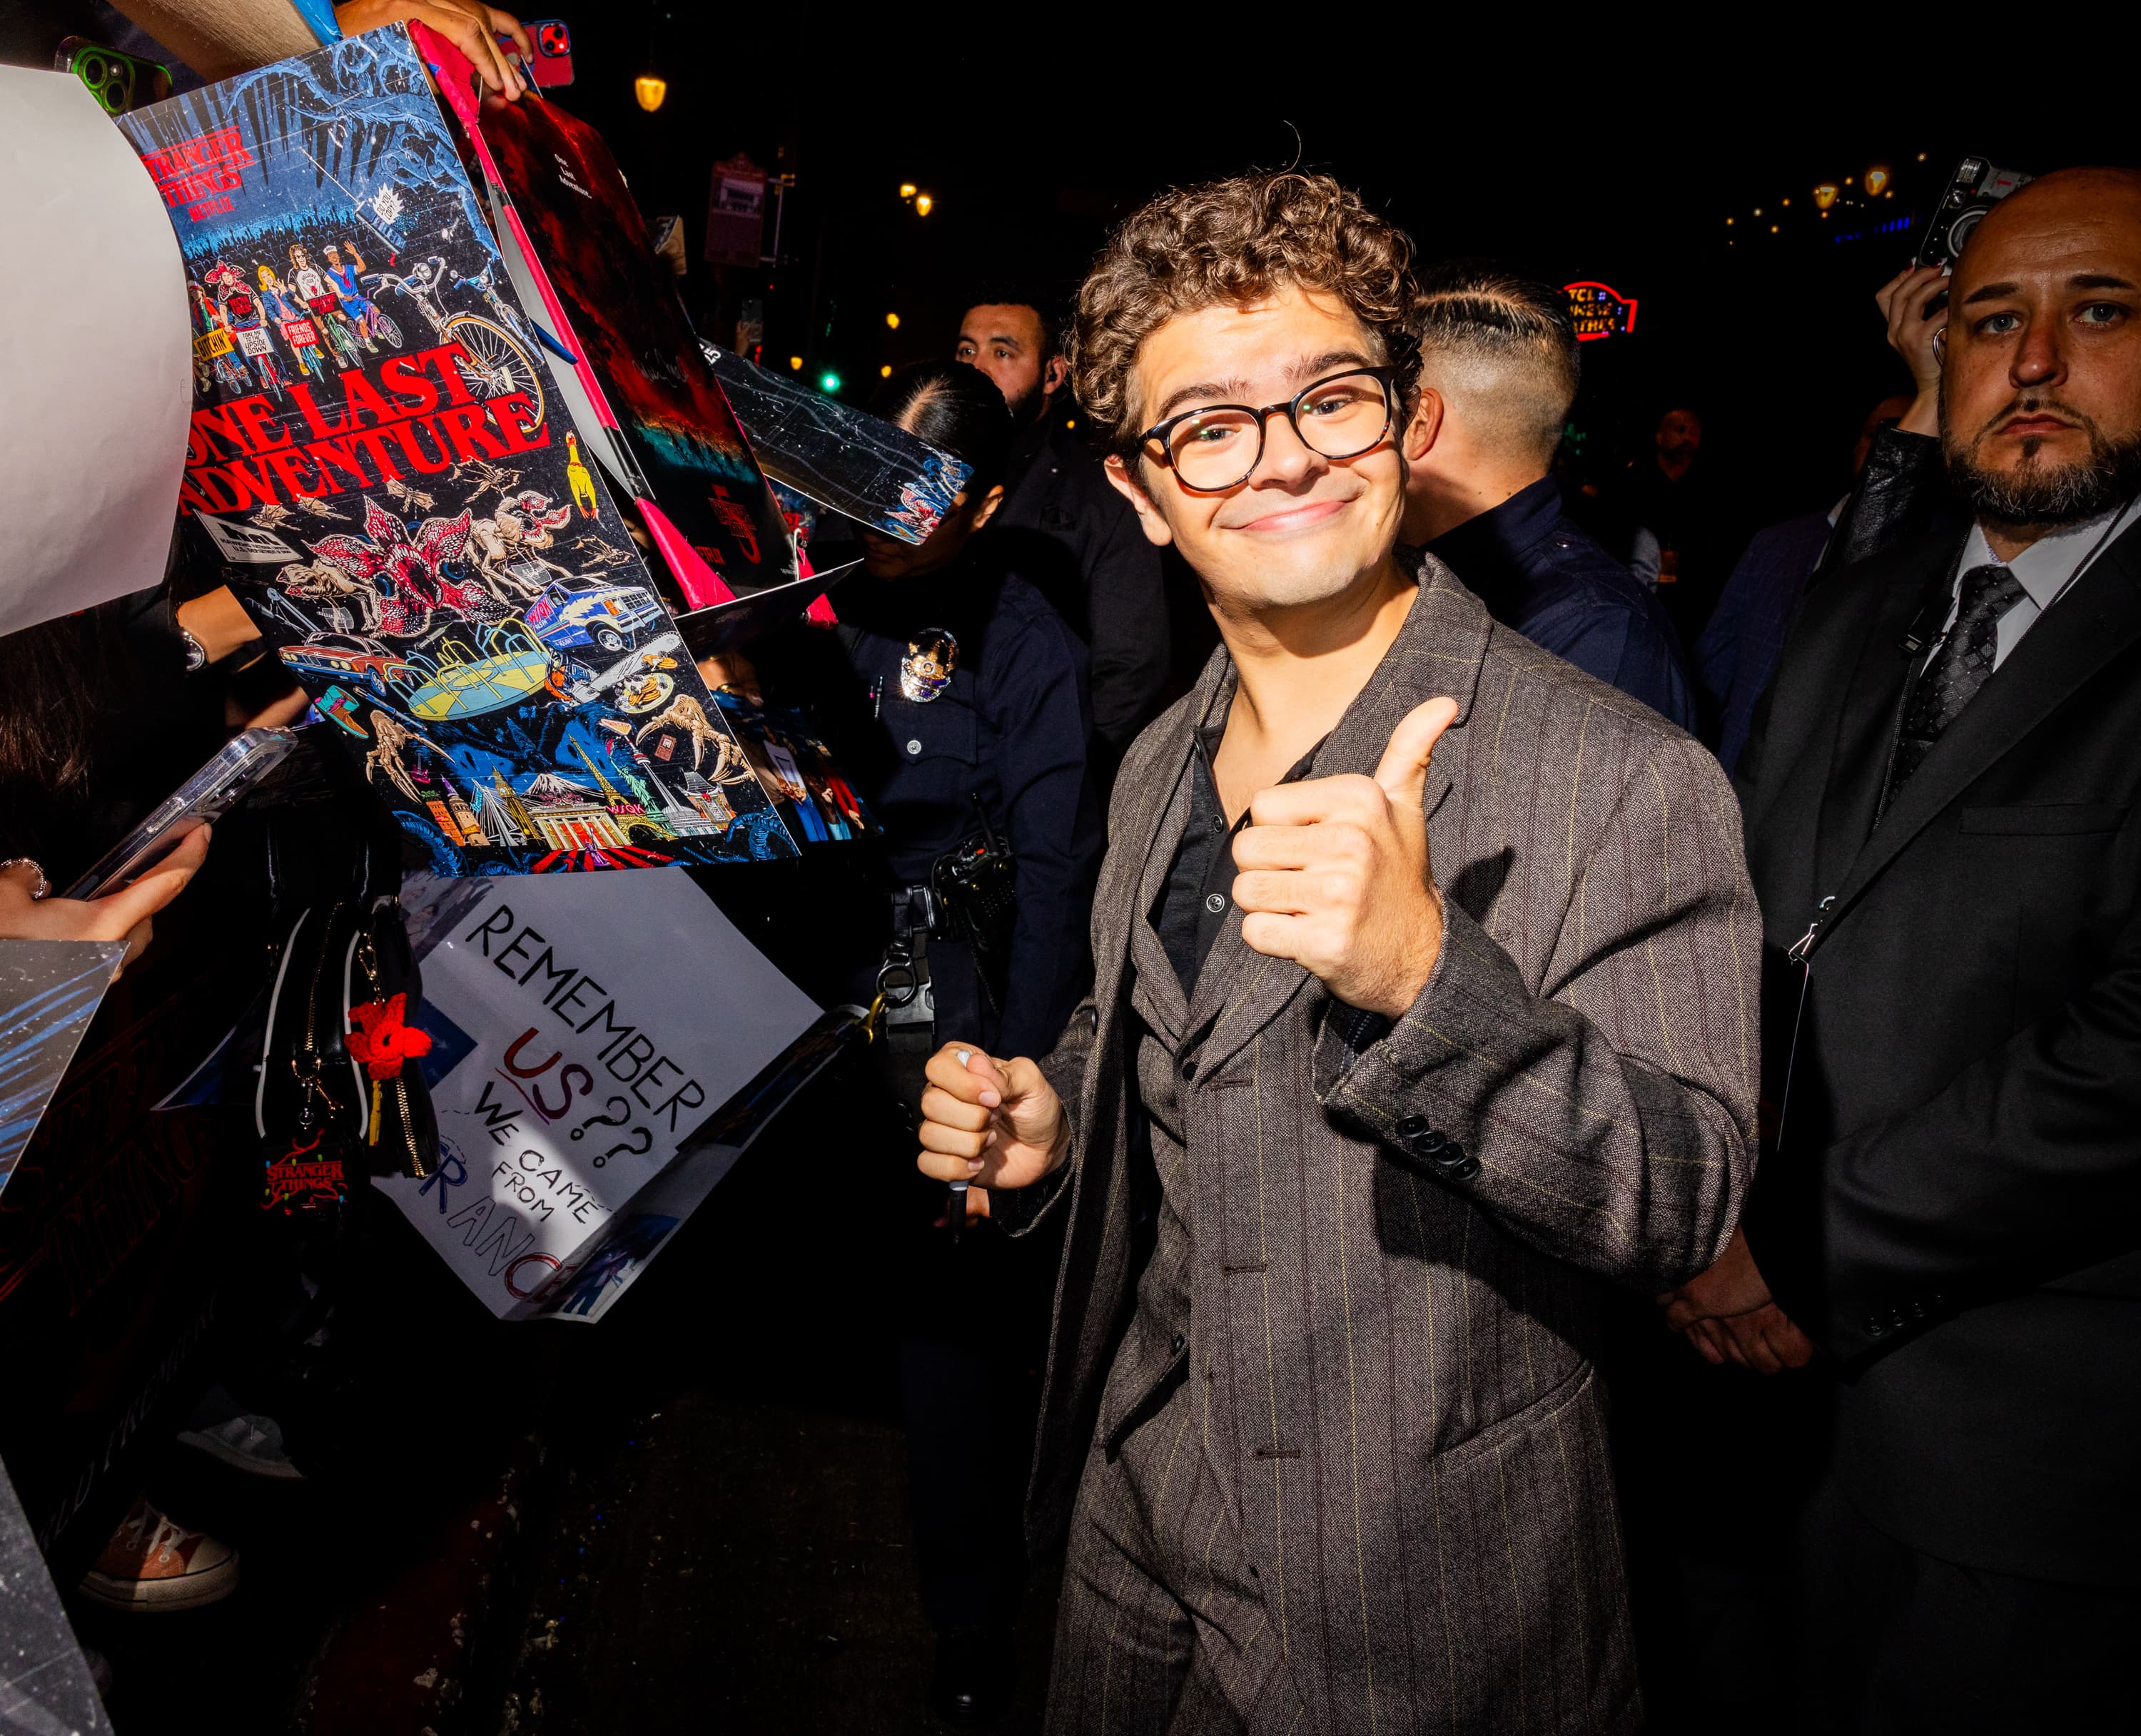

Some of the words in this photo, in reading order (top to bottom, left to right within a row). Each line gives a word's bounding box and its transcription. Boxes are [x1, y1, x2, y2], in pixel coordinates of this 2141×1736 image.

[143, 132, 253, 183] TRANGER
[159, 164, 242, 208] THINGS
[382, 191, 392, 206] YOU
[187, 196, 236, 223] NETFLIX
[1569, 288, 1595, 302] TCL
[287, 322, 312, 335] FRIENDS
[245, 339, 266, 349] UPSIDE
[292, 332, 316, 345] FOREVER
[248, 346, 267, 355] DOWN
[286, 342, 477, 440] LAST
[695, 546, 726, 565] ETFLIX
[605, 803, 646, 816] WSQK
[465, 904, 705, 1132] REMEMBER
[475, 1081, 524, 1147] WE
[519, 1149, 599, 1225] CAME
[266, 1162, 345, 1182] STRANGER
[280, 1177, 333, 1191] THINGS
[491, 1160, 555, 1223] FROM
